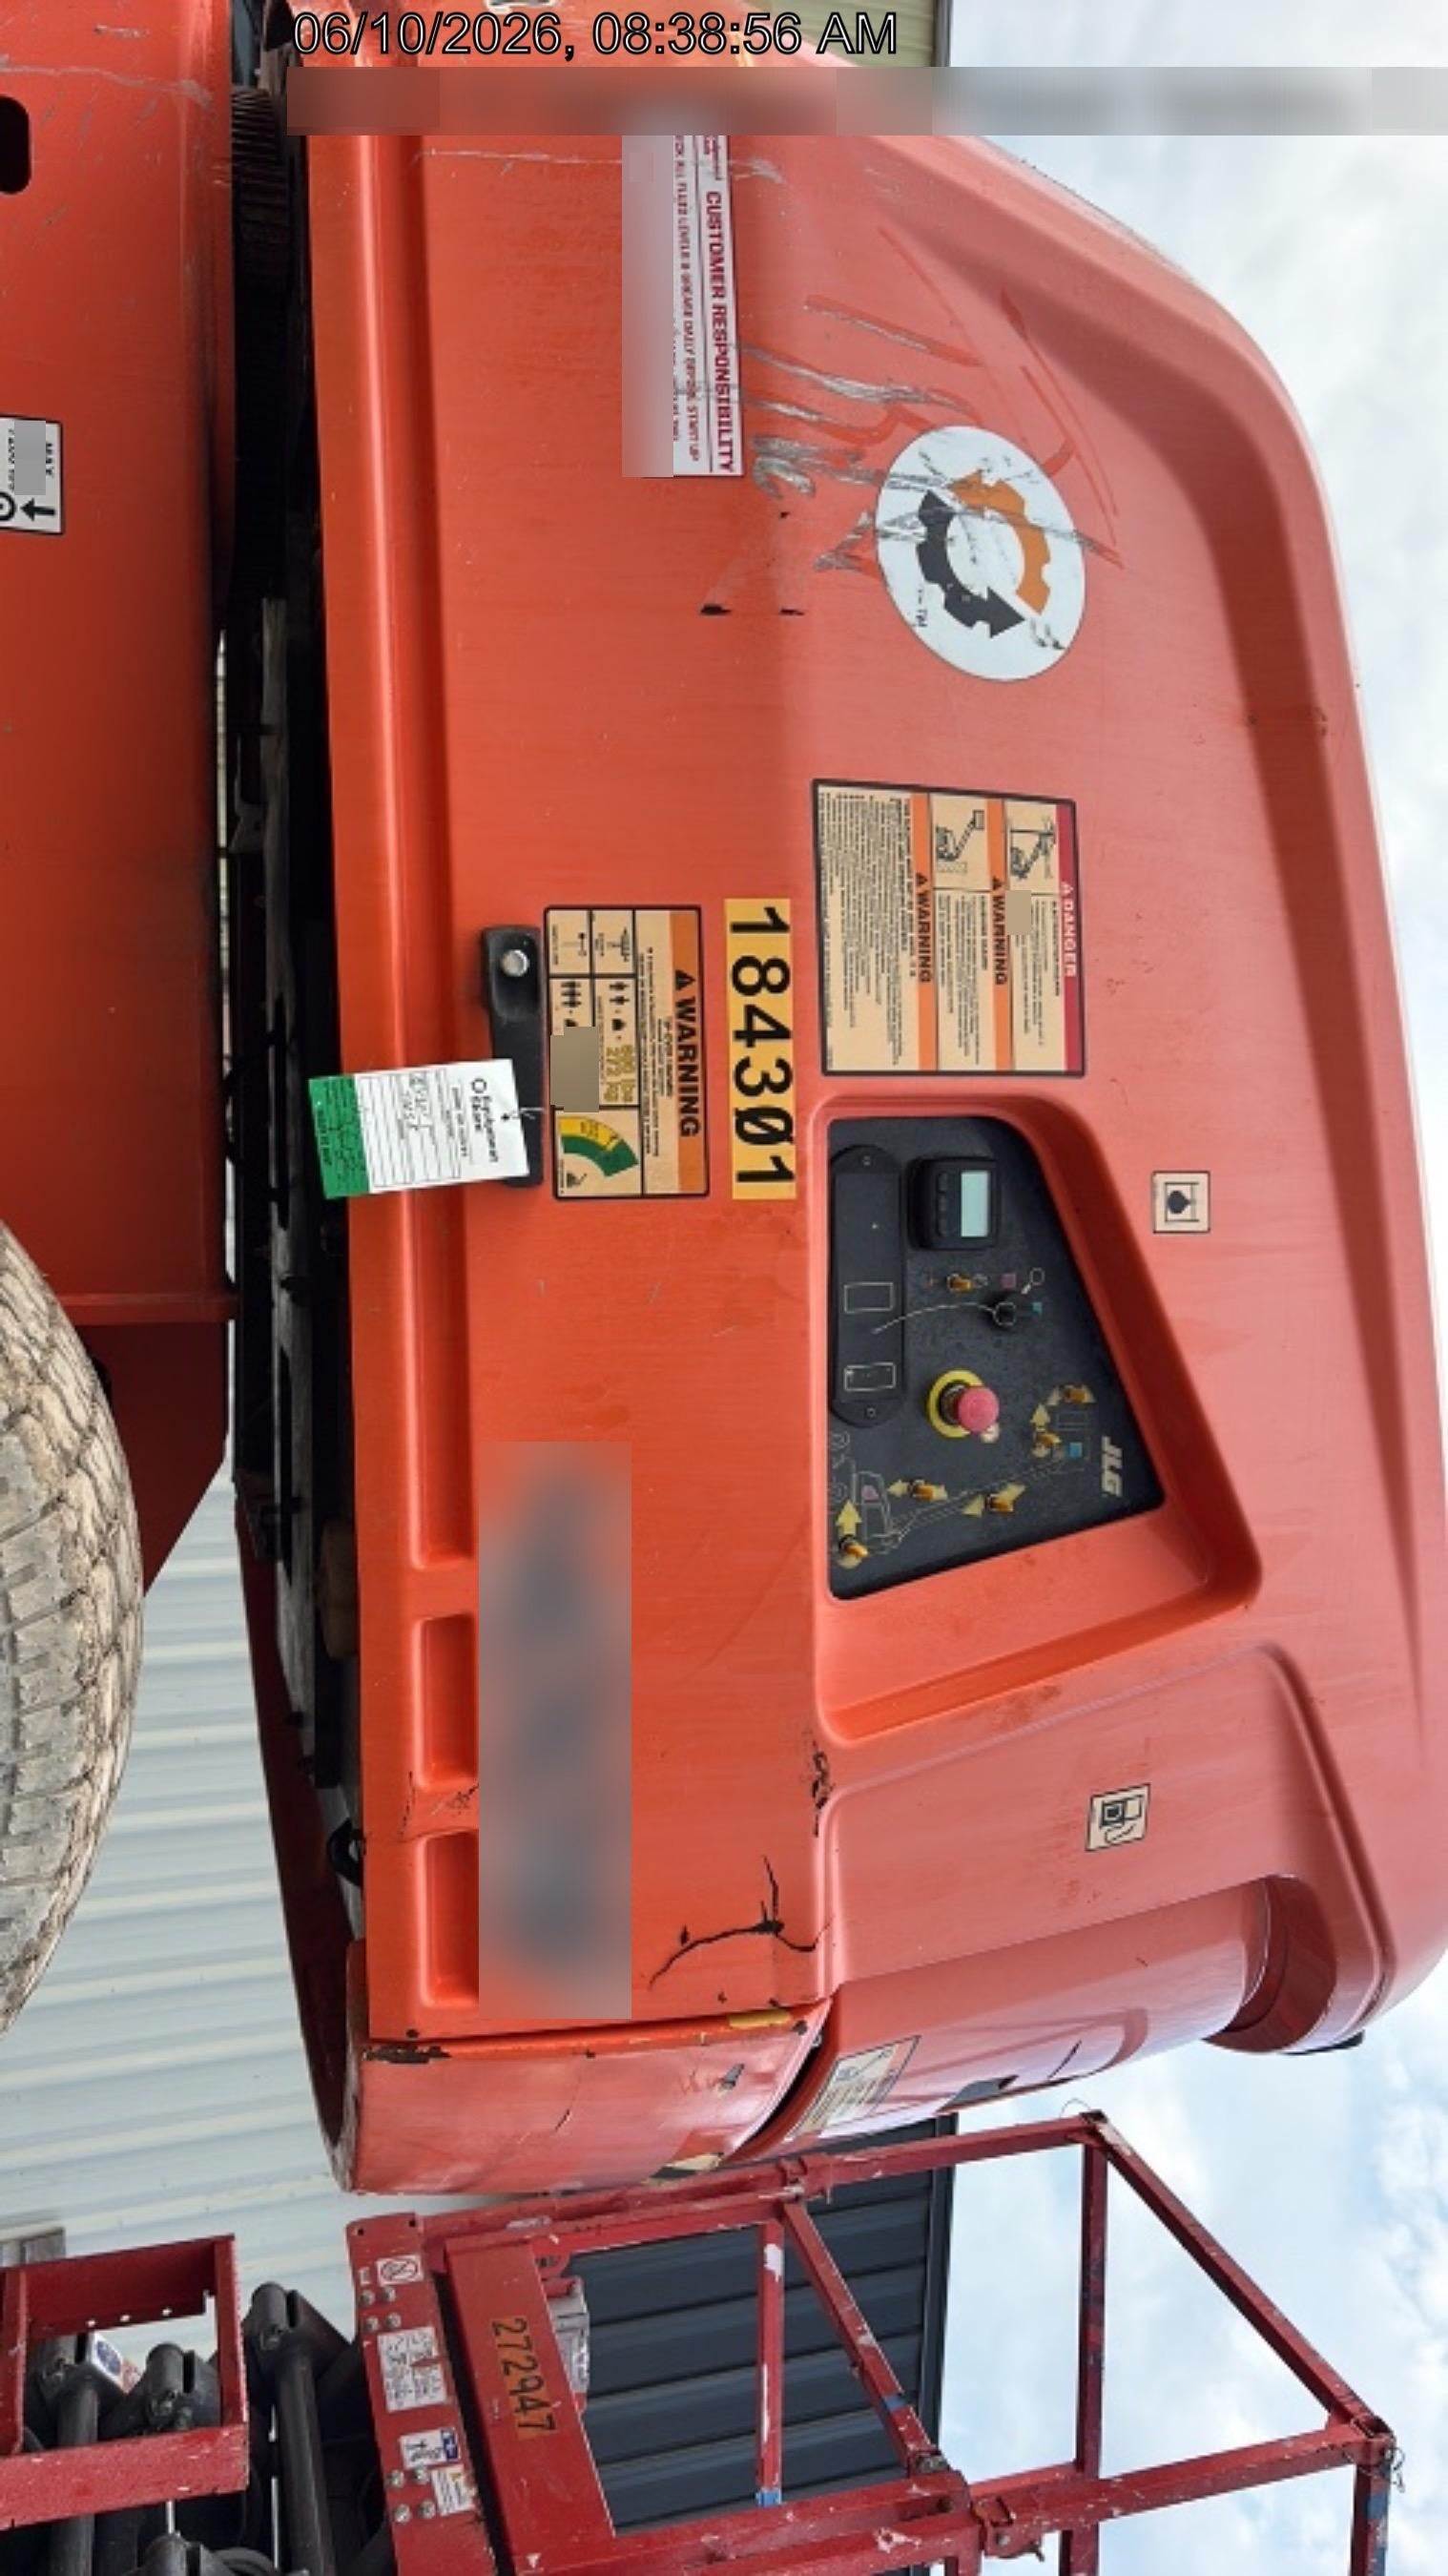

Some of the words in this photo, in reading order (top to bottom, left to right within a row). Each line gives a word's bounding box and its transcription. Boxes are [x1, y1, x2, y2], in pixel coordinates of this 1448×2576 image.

[706, 191, 727, 299] CUSTOMER
[688, 406, 698, 442] START
[712, 303, 734, 472] RESPONSIBILITY
[918, 890, 931, 983] WARNING
[992, 895, 1005, 986] WARNING
[1063, 899, 1076, 977] DANGER
[676, 996, 700, 1137] WARNING
[730, 906, 796, 1185] 184301
[1101, 1436, 1122, 1497] JLG
[492, 2318, 557, 2431] 272947
